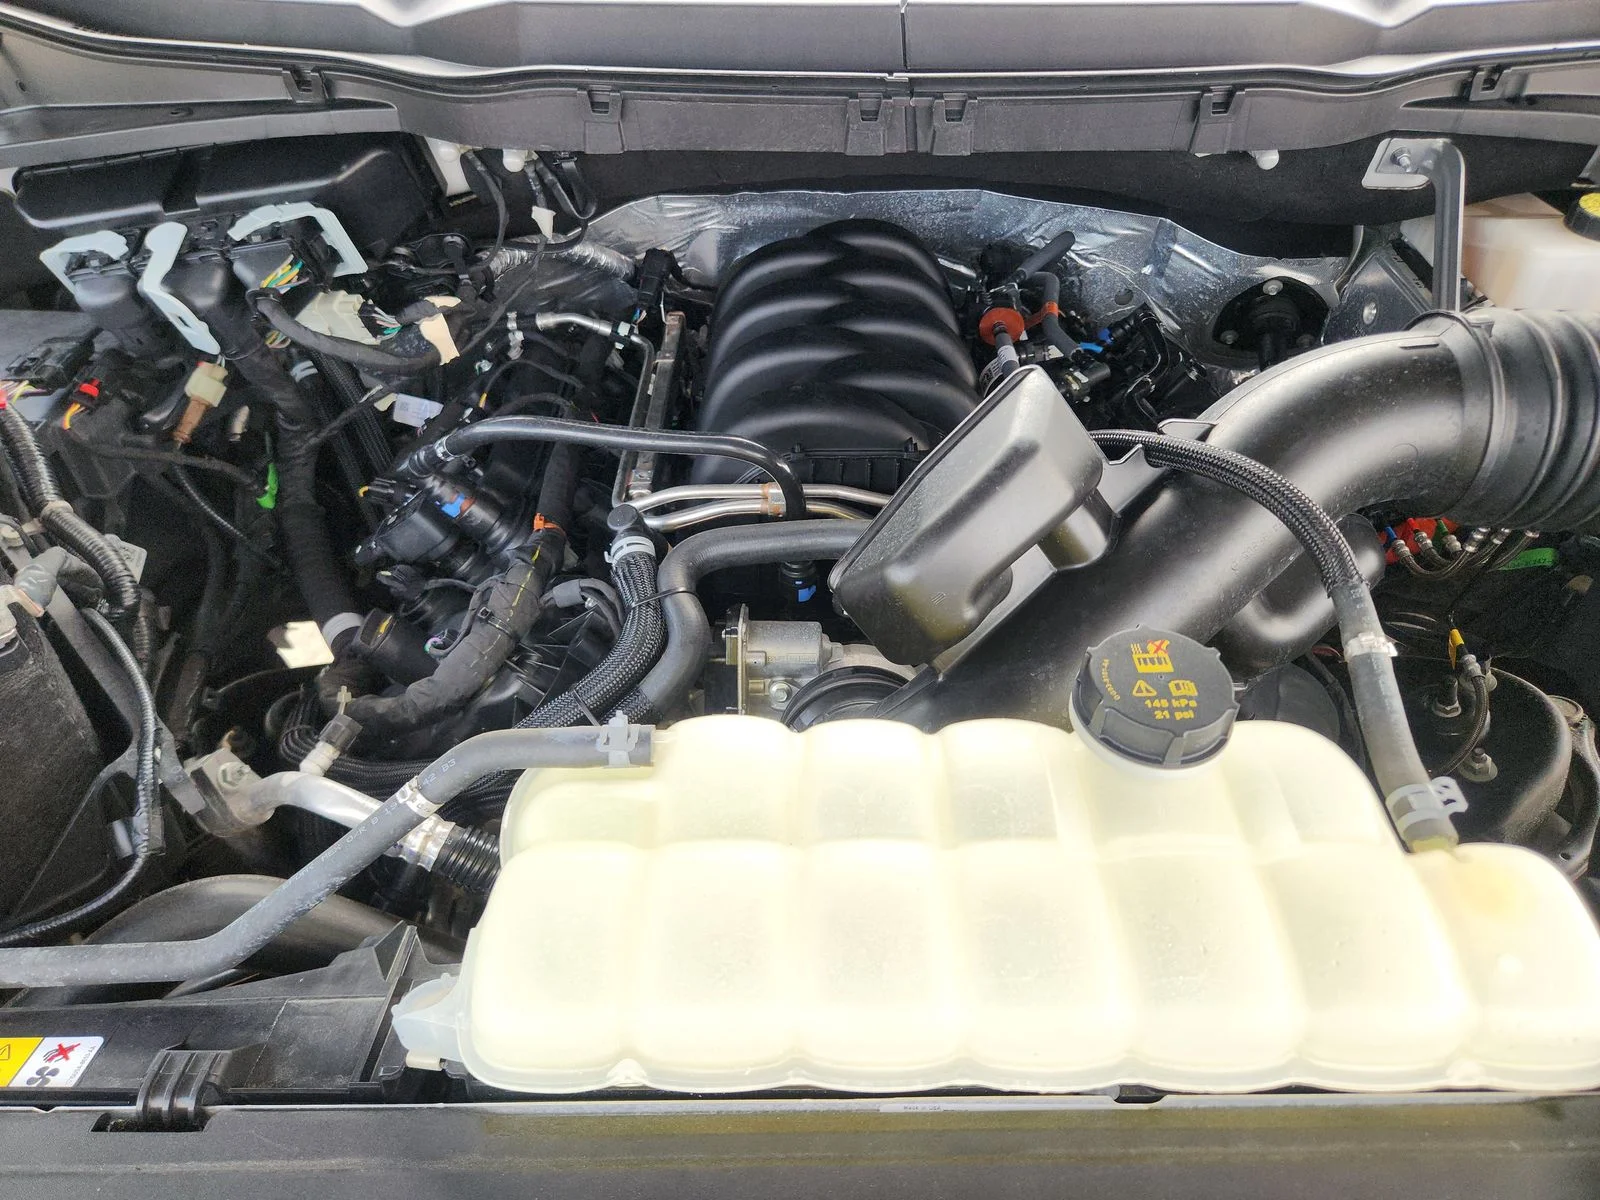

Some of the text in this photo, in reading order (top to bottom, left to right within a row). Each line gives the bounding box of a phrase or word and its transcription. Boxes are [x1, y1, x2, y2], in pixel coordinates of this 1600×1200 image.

[1144, 698, 1197, 708] 145 kPa
[1154, 710, 1195, 721] 21 psi
